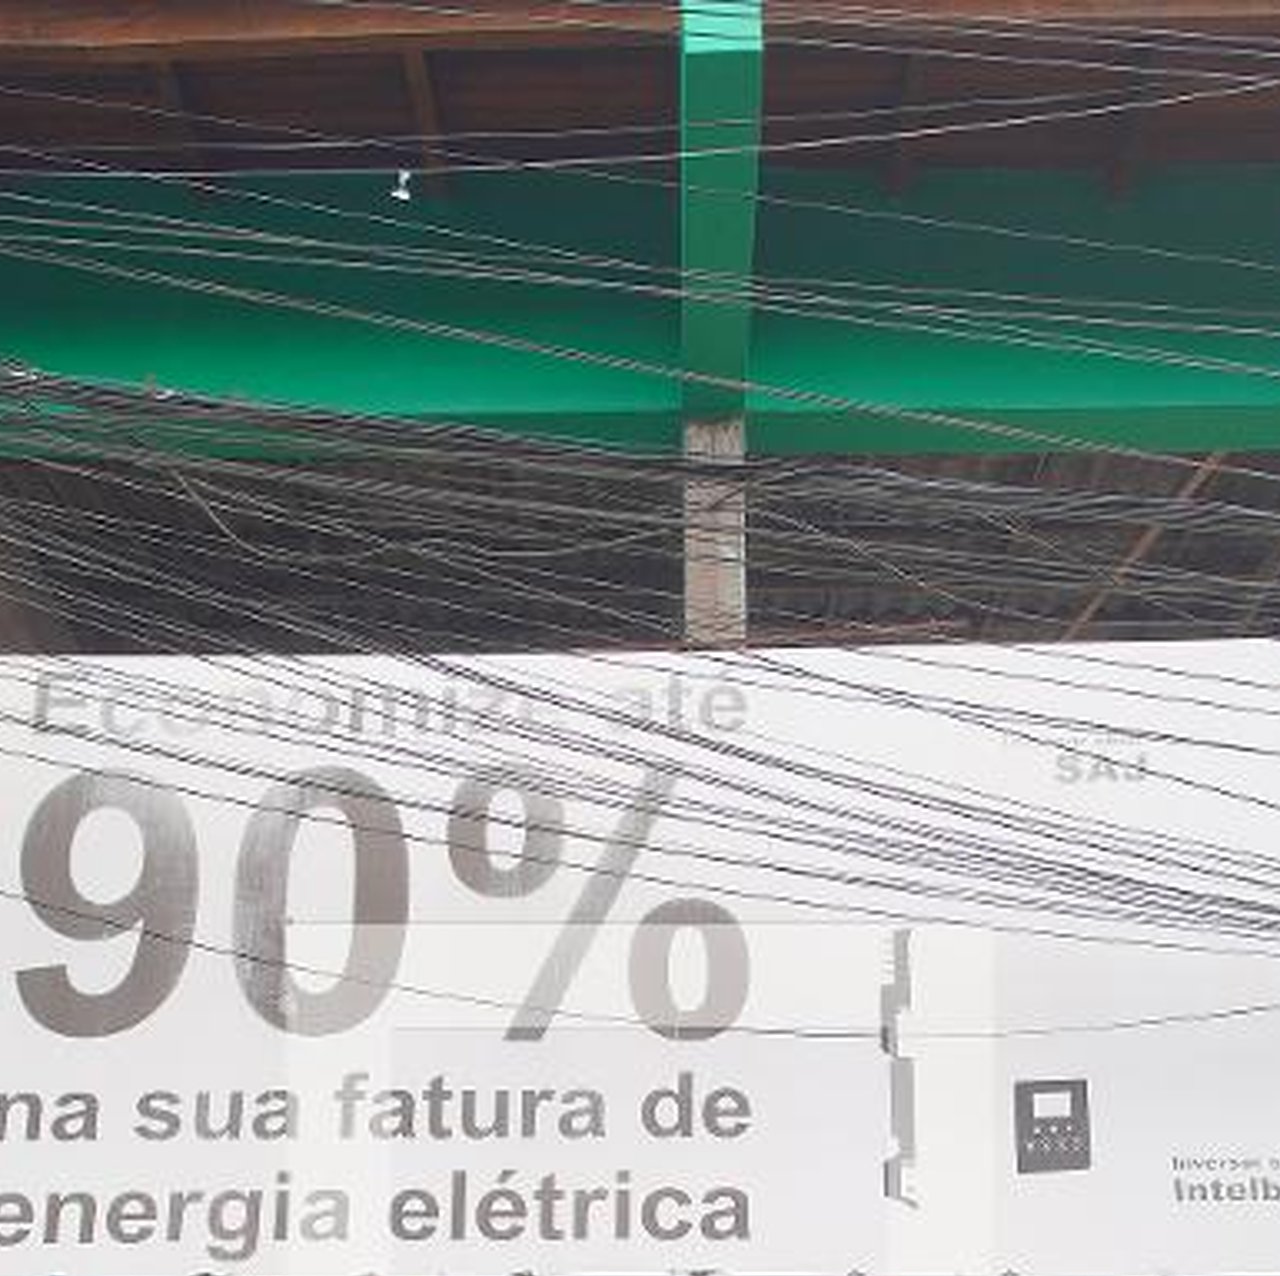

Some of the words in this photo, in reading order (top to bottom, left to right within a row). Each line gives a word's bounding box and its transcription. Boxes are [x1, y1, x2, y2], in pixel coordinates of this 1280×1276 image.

[14, 763, 752, 1043] 90%
[133, 1087, 300, 1142] sua
[334, 1073, 606, 1142] fatura
[641, 1072, 752, 1142] de
[389, 1170, 752, 1243] elétrica
